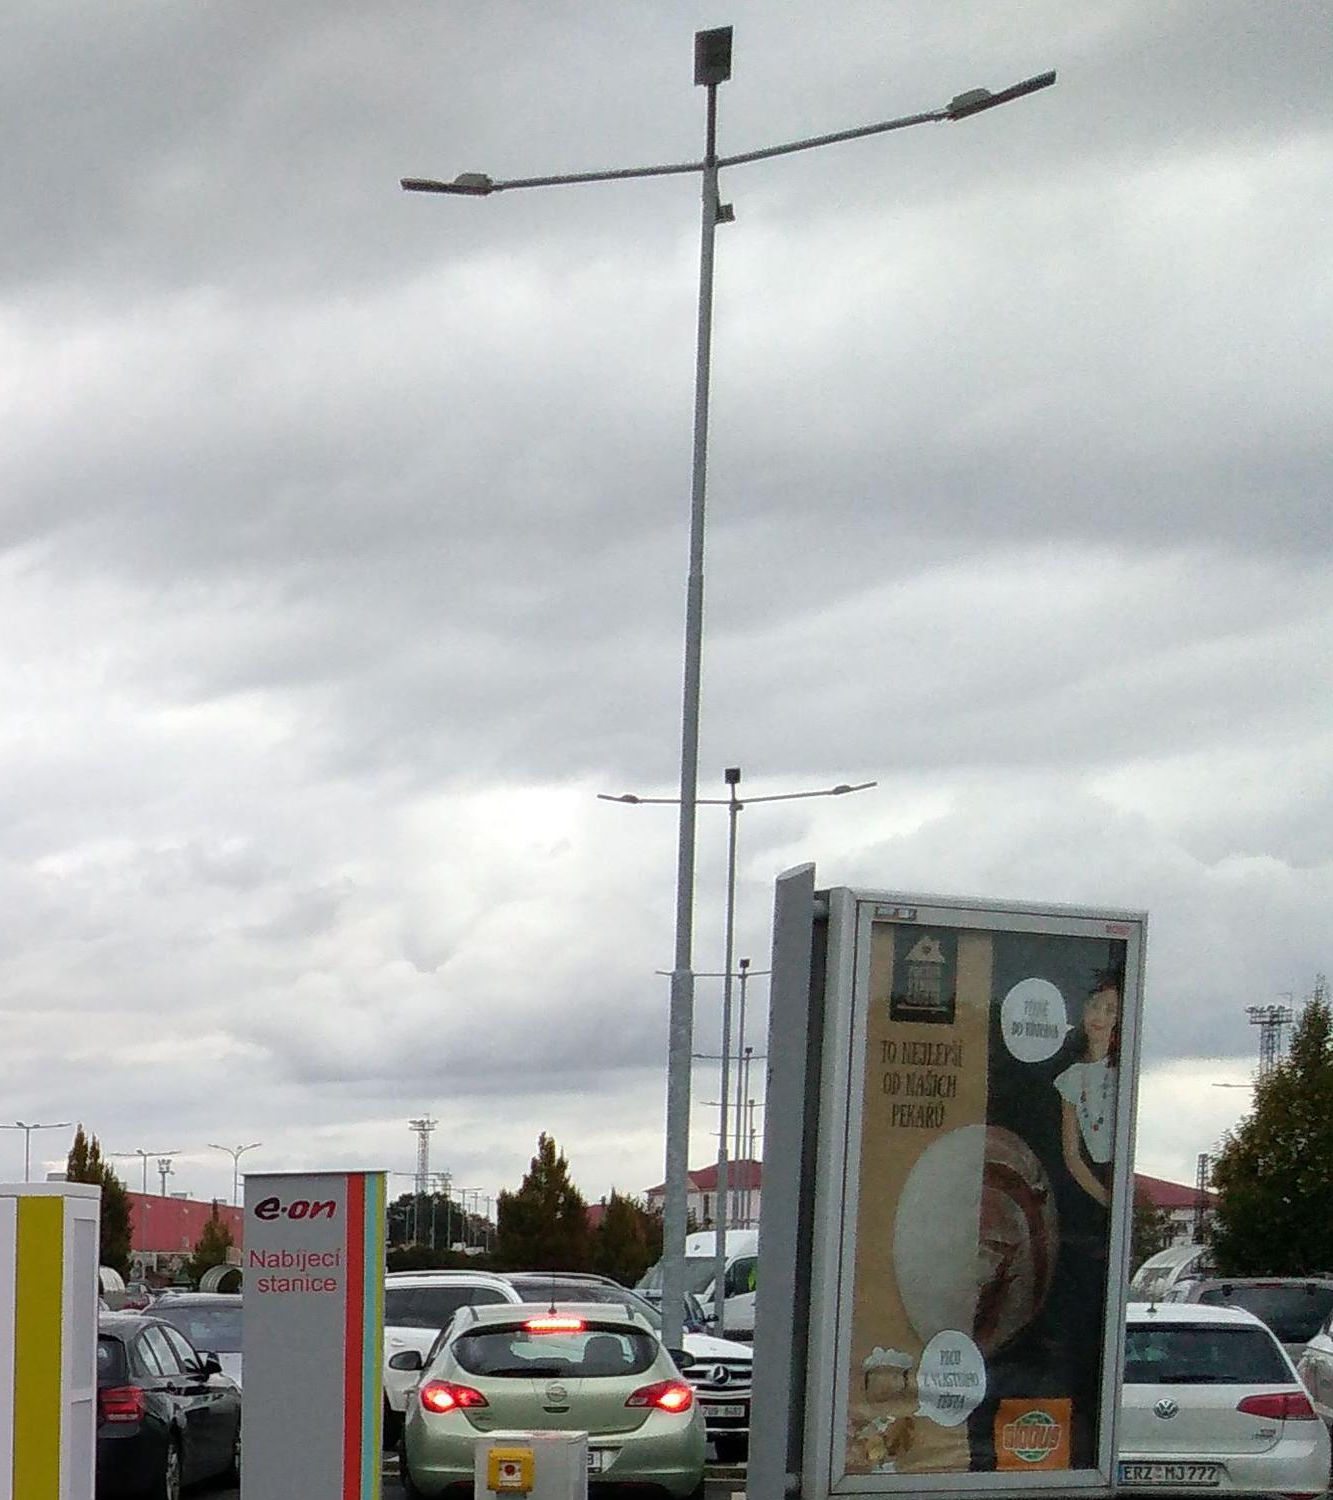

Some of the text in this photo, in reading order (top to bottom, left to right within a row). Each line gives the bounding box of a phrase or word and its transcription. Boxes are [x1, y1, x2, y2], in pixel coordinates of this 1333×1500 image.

[881, 1040, 898, 1066] TO
[884, 1071, 957, 1098] OD NAŠICH
[249, 1247, 342, 1273] Nabíjecí
[258, 1274, 337, 1293] stanice
[1123, 1466, 1153, 1482] ERZ
